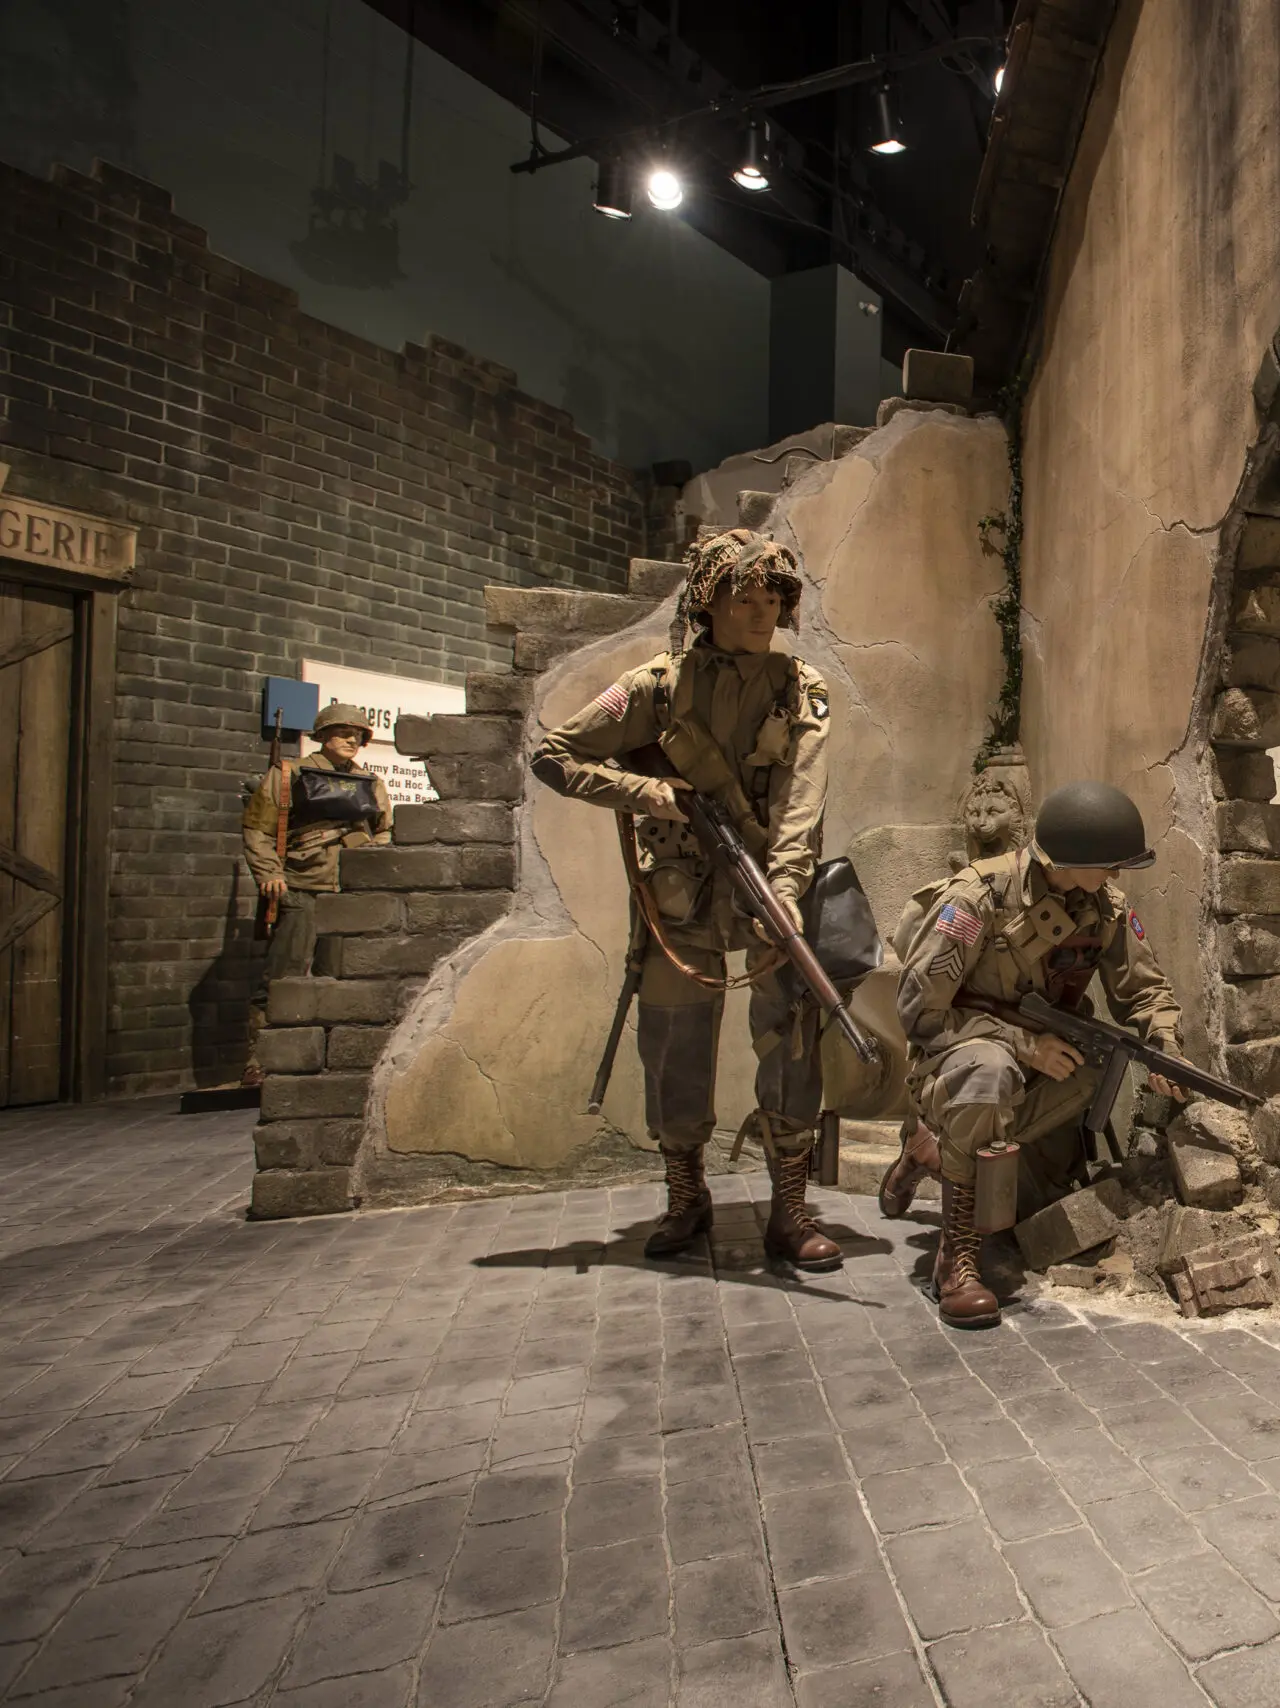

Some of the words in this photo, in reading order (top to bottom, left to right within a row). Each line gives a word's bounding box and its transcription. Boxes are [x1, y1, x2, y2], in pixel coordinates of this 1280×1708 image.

[363, 761, 389, 774] Army
[388, 779, 400, 788] du
[404, 779, 423, 790] Hoc
